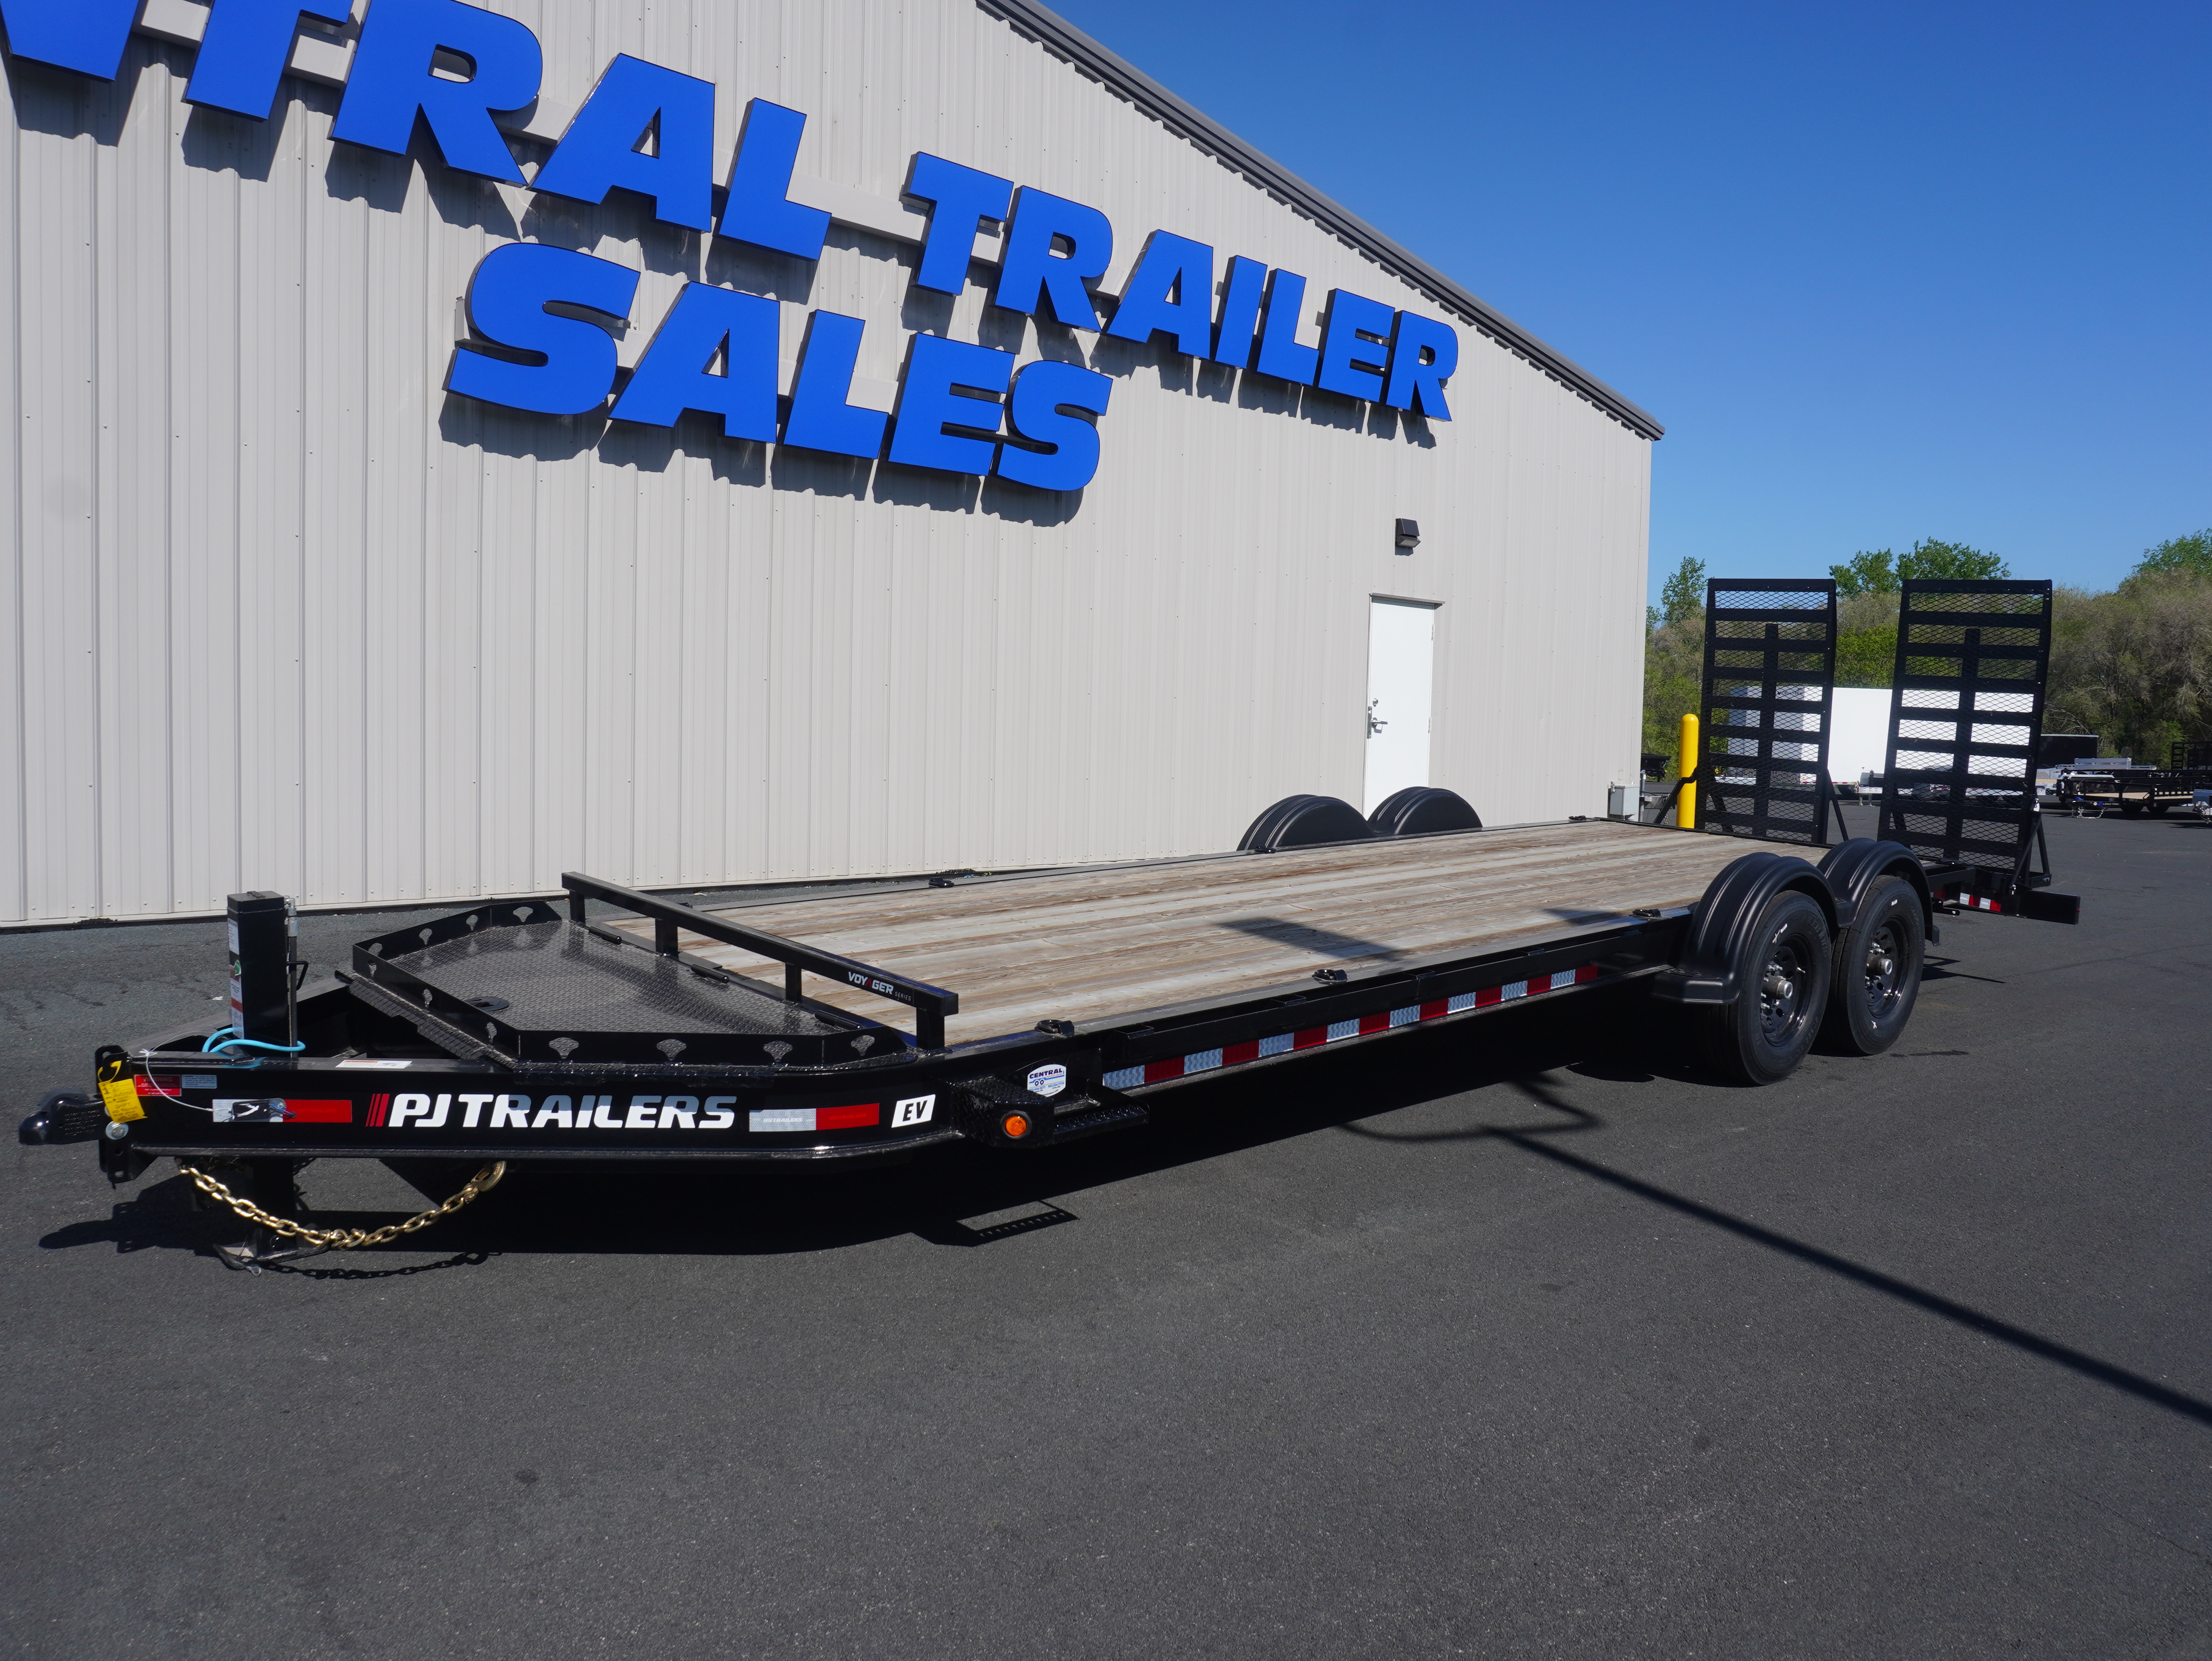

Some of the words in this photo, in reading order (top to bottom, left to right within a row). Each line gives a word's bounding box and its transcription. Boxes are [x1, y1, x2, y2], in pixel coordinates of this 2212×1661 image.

[0, 0, 832, 261] TRAL
[900, 151, 1458, 421] TRAILER
[445, 243, 1113, 492] SALES
[848, 971, 894, 995] VOYAGER
[895, 991, 911, 1001] SERIES
[1029, 1068, 1063, 1079] CENTRAL
[388, 1093, 452, 1127] PJ
[458, 1094, 737, 1129] TRAILERS
[903, 1100, 927, 1122] EV
